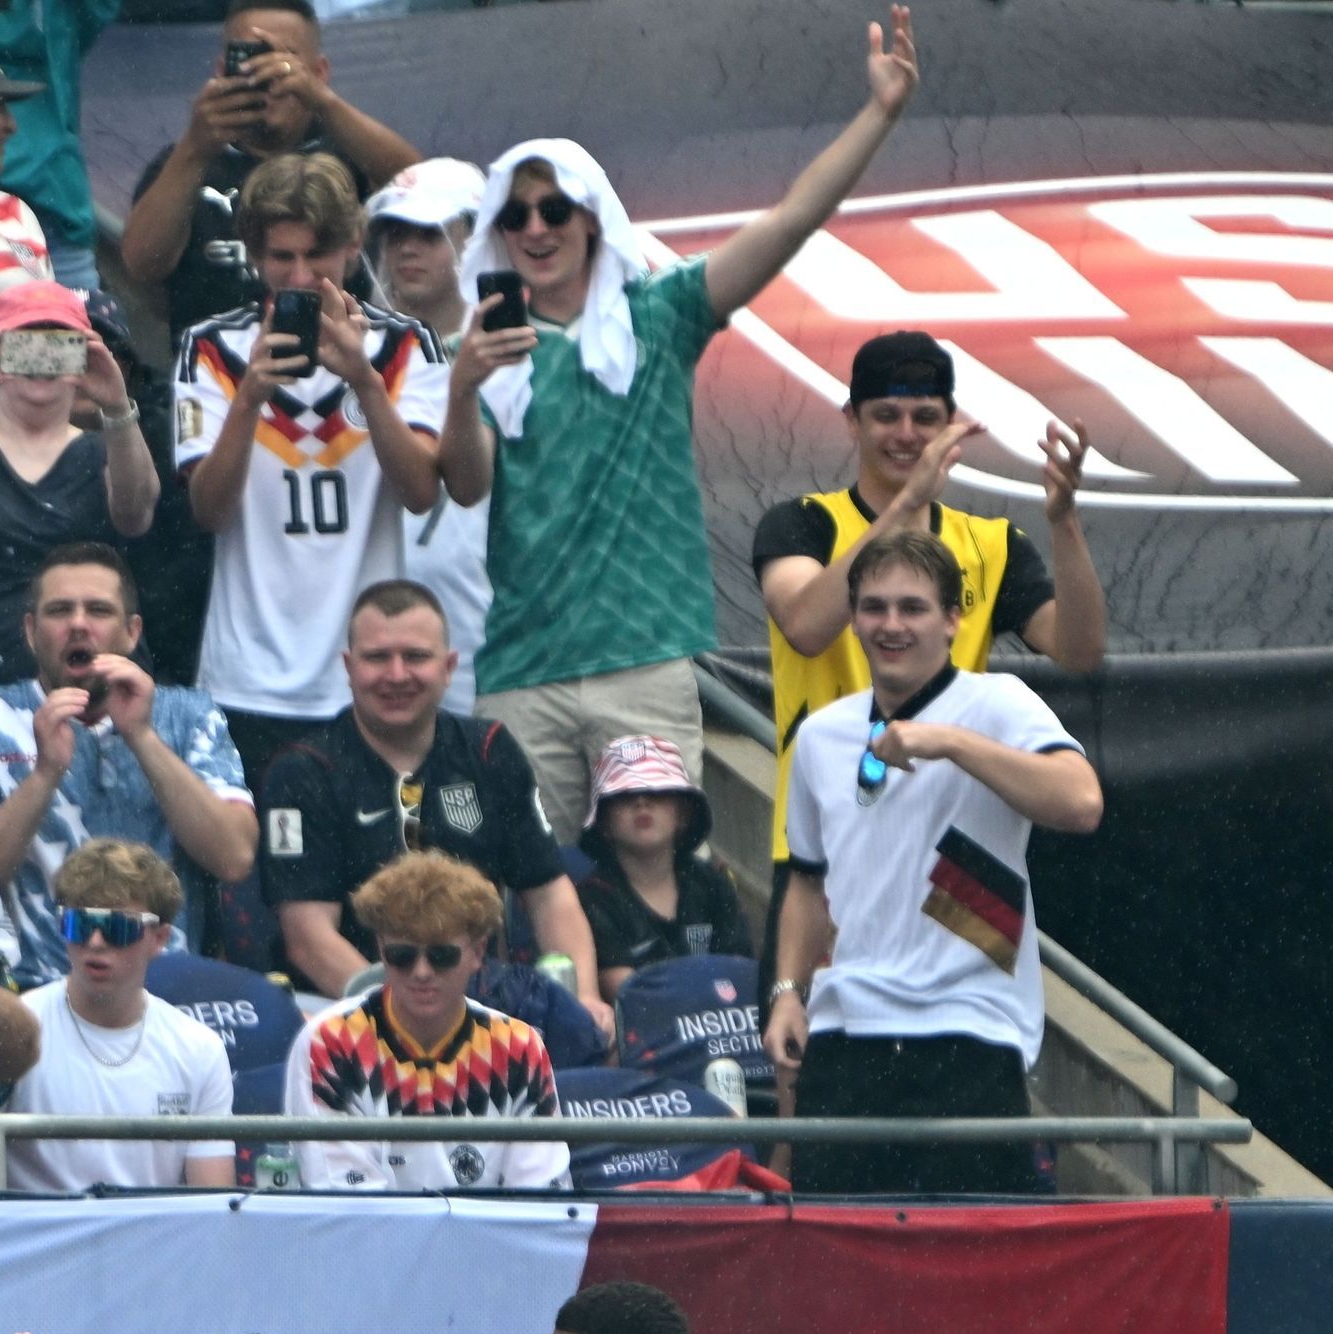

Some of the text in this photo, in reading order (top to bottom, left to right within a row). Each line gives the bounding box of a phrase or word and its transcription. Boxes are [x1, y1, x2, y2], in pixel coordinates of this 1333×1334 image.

[282, 469, 349, 536] 10
[445, 788, 476, 807] USA
[708, 1033, 763, 1056] SECTI
[567, 1089, 692, 1118] INSIDERS
